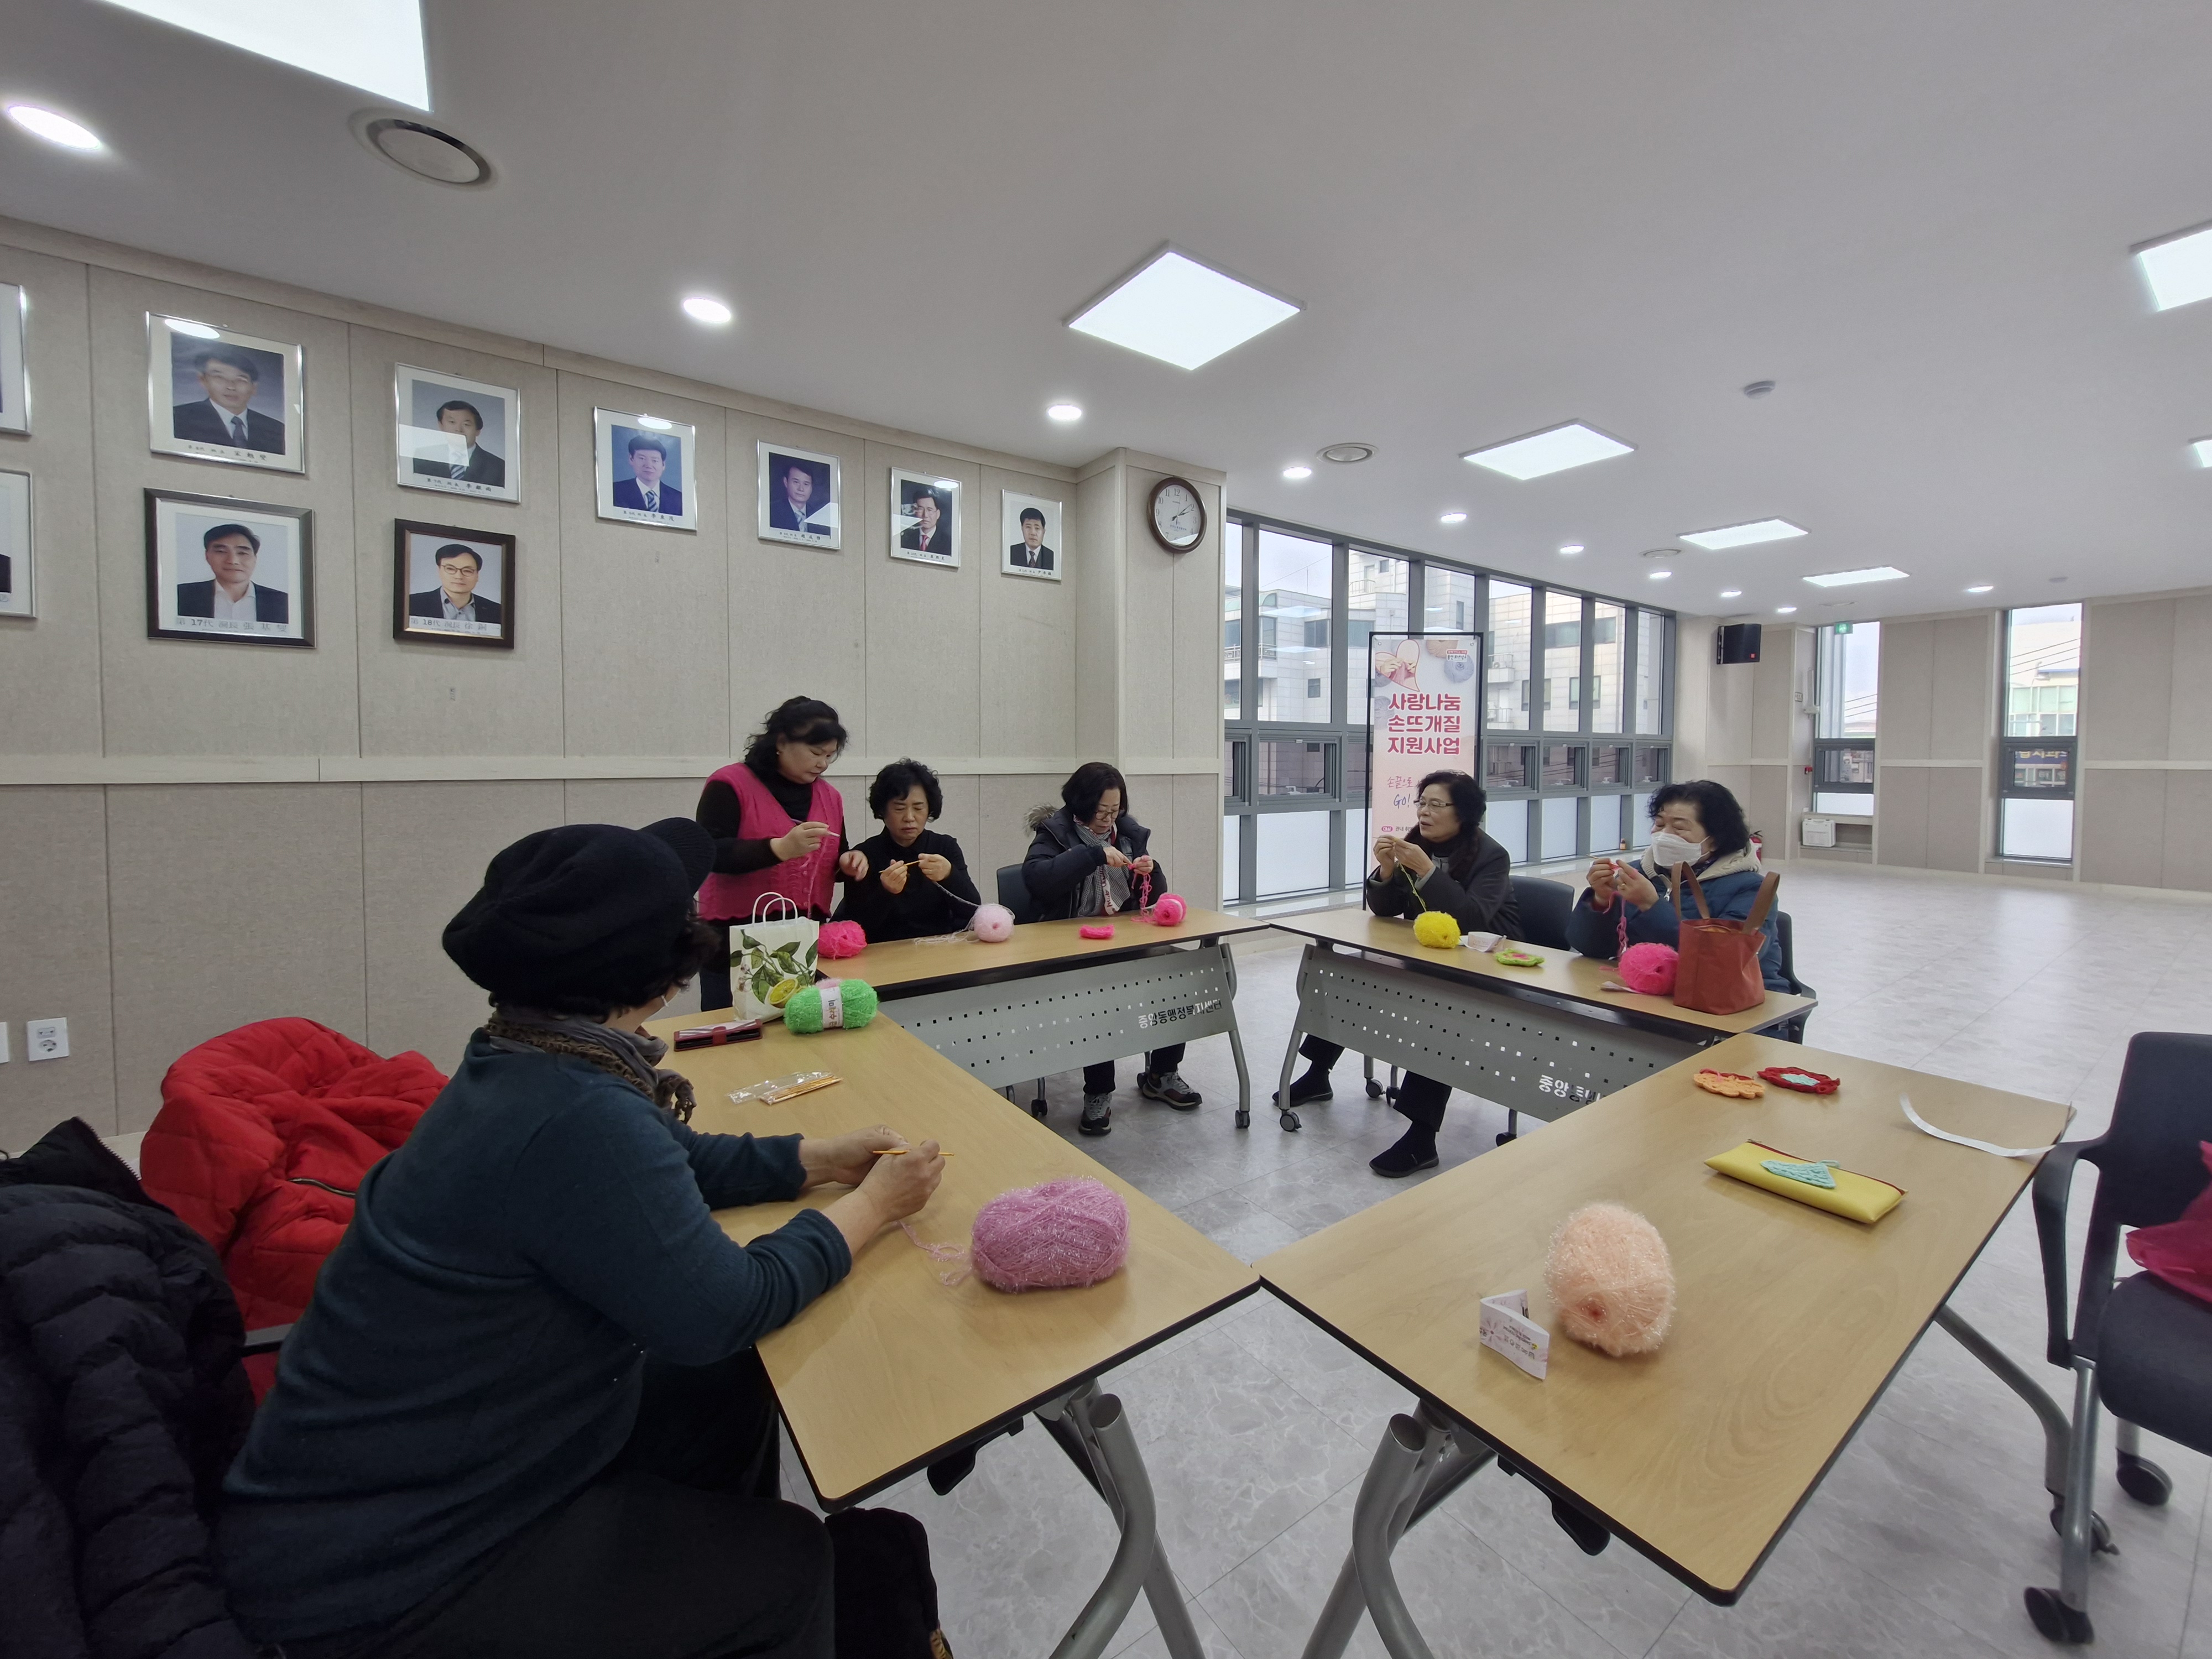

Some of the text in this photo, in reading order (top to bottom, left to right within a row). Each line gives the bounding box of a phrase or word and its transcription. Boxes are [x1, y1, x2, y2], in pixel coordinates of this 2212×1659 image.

[1165, 489, 1170, 497] 11
[1173, 488, 1180, 497] 12
[1389, 693, 1461, 711] 사랑나눔
[1388, 714, 1460, 733] 손뜨개질
[1387, 737, 1459, 754] 지원사업
[1387, 776, 1415, 789] 손끝으로
[1394, 794, 1410, 809] GO!
[1138, 998, 1223, 1029] 중앙동행정복지센터
